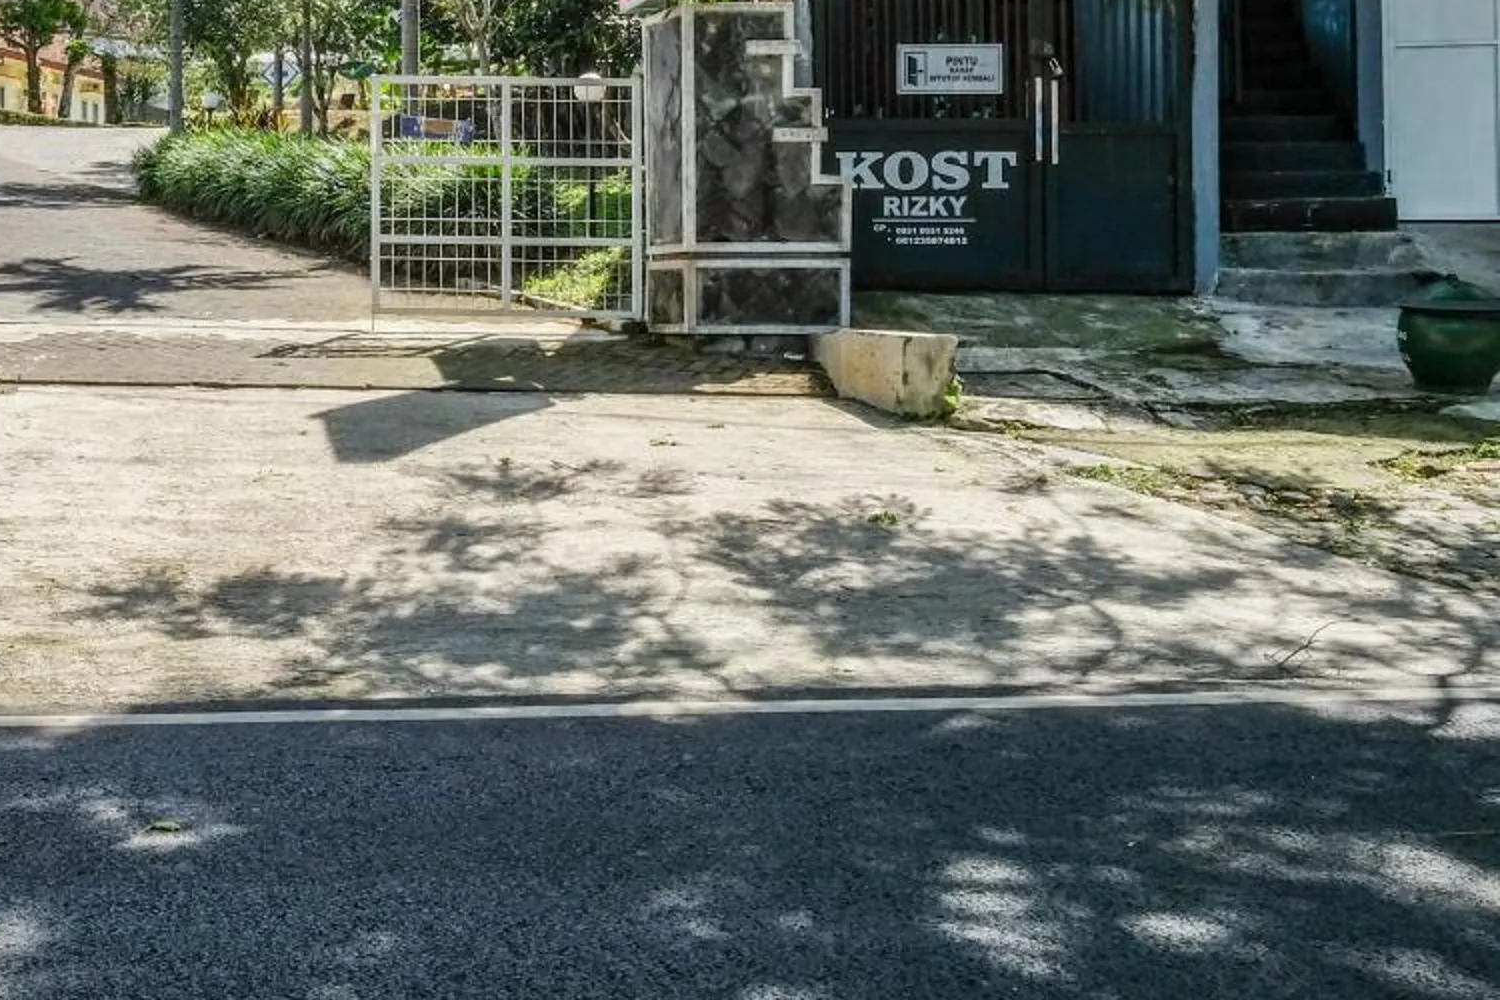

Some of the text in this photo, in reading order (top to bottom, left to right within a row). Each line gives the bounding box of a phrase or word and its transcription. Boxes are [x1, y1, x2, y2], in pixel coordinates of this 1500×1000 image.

[945, 55, 979, 68] PINTU
[835, 150, 1018, 191] KOST
[883, 195, 968, 217] RIZKY
